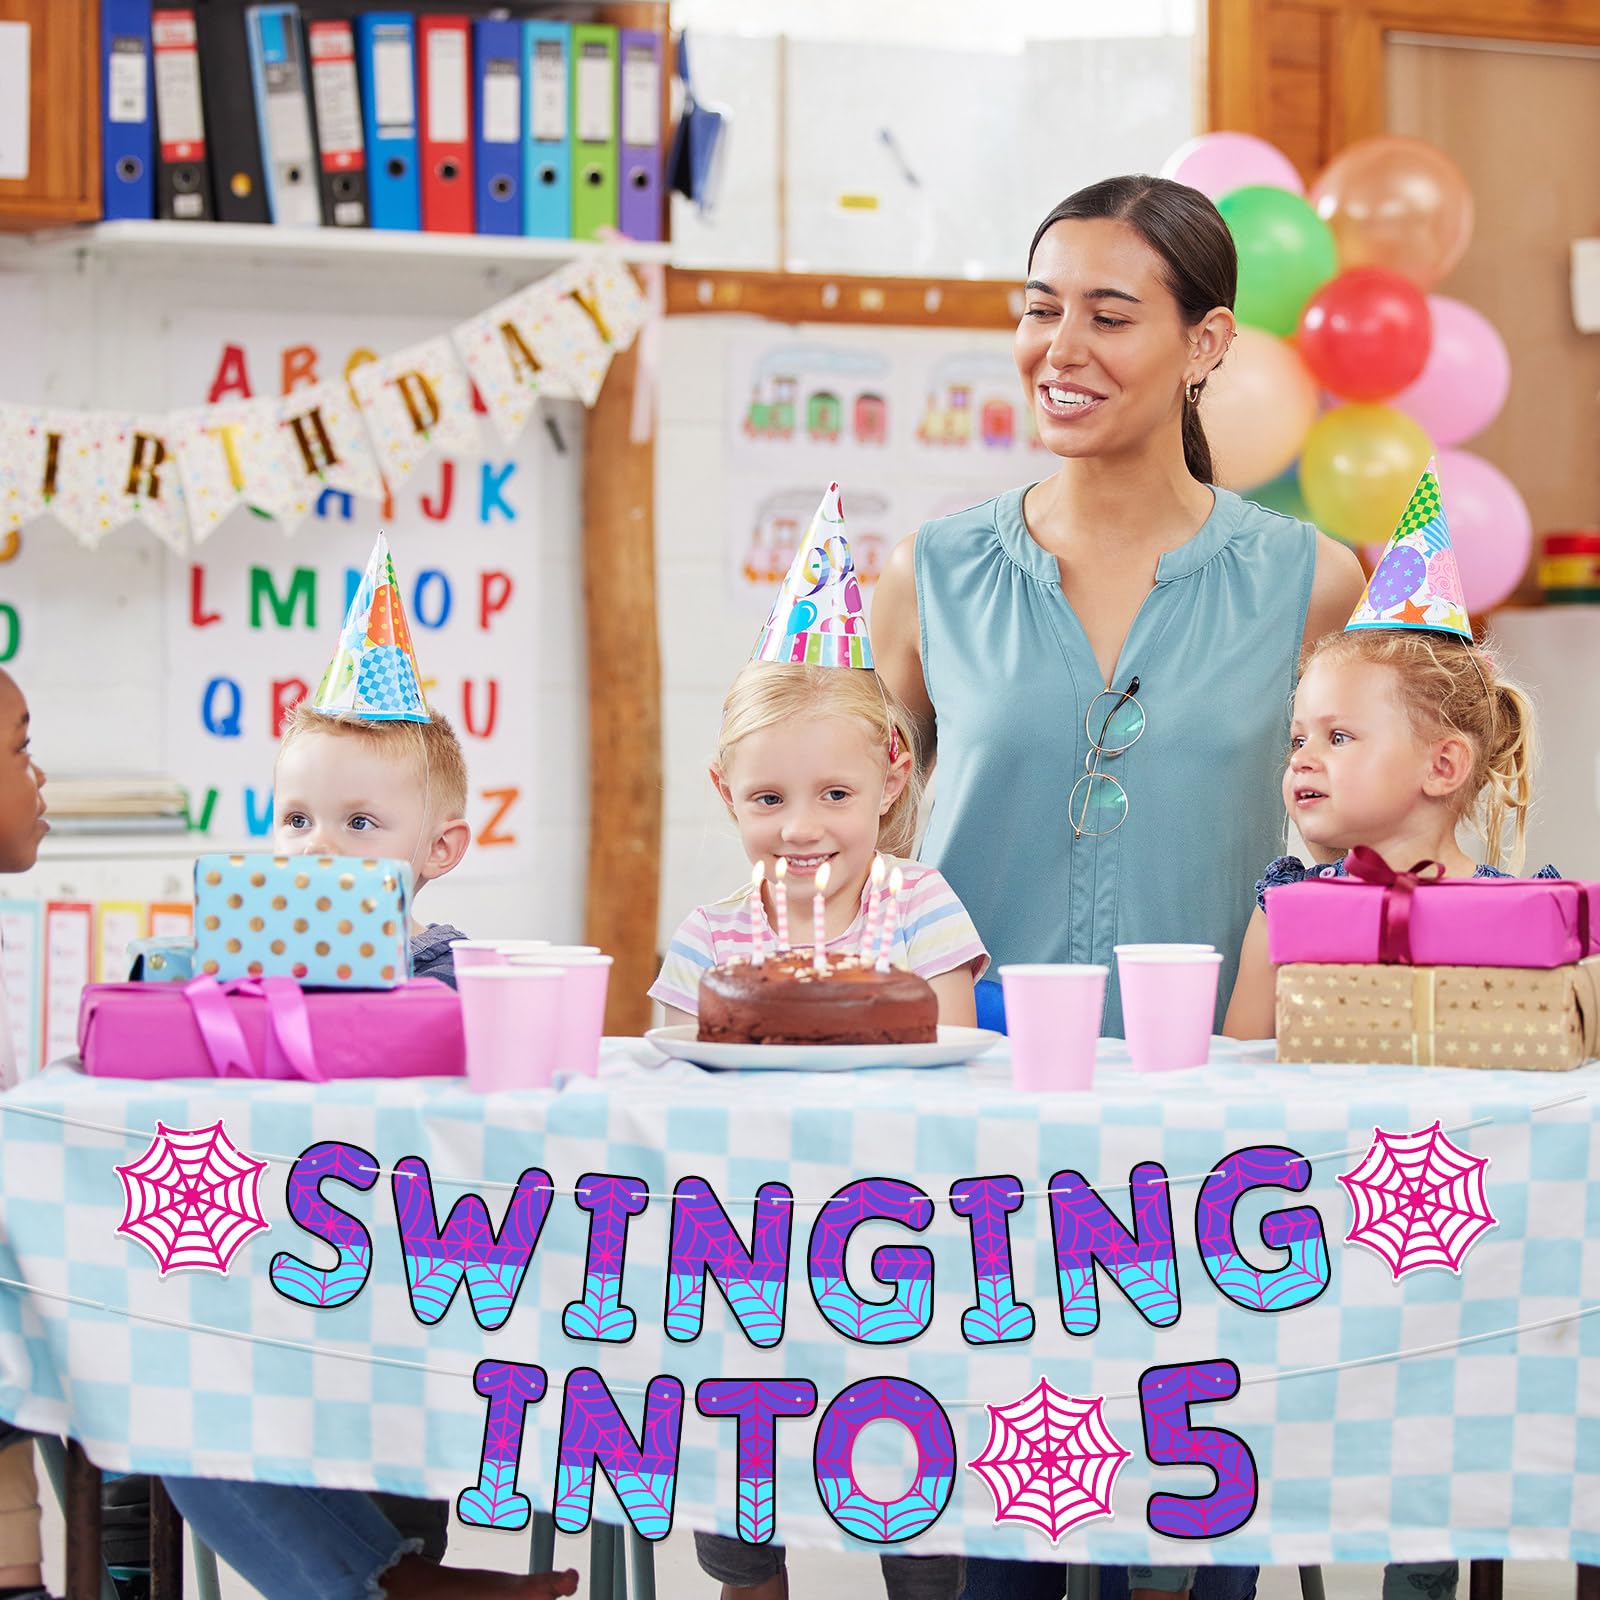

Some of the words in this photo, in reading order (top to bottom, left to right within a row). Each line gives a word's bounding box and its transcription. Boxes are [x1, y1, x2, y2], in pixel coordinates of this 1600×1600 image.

[207, 342, 253, 403] A
[420, 460, 454, 521] J
[480, 460, 516, 522] K
[190, 563, 222, 628] L
[249, 565, 318, 628] M
[412, 567, 453, 630] O
[480, 570, 514, 631] P
[201, 676, 245, 738] Q
[463, 678, 498, 739] U
[476, 787, 521, 847] Z
[270, 1140, 1332, 1348] SWINGING
[457, 1359, 957, 1544] INTO
[1138, 1358, 1259, 1540] 5
